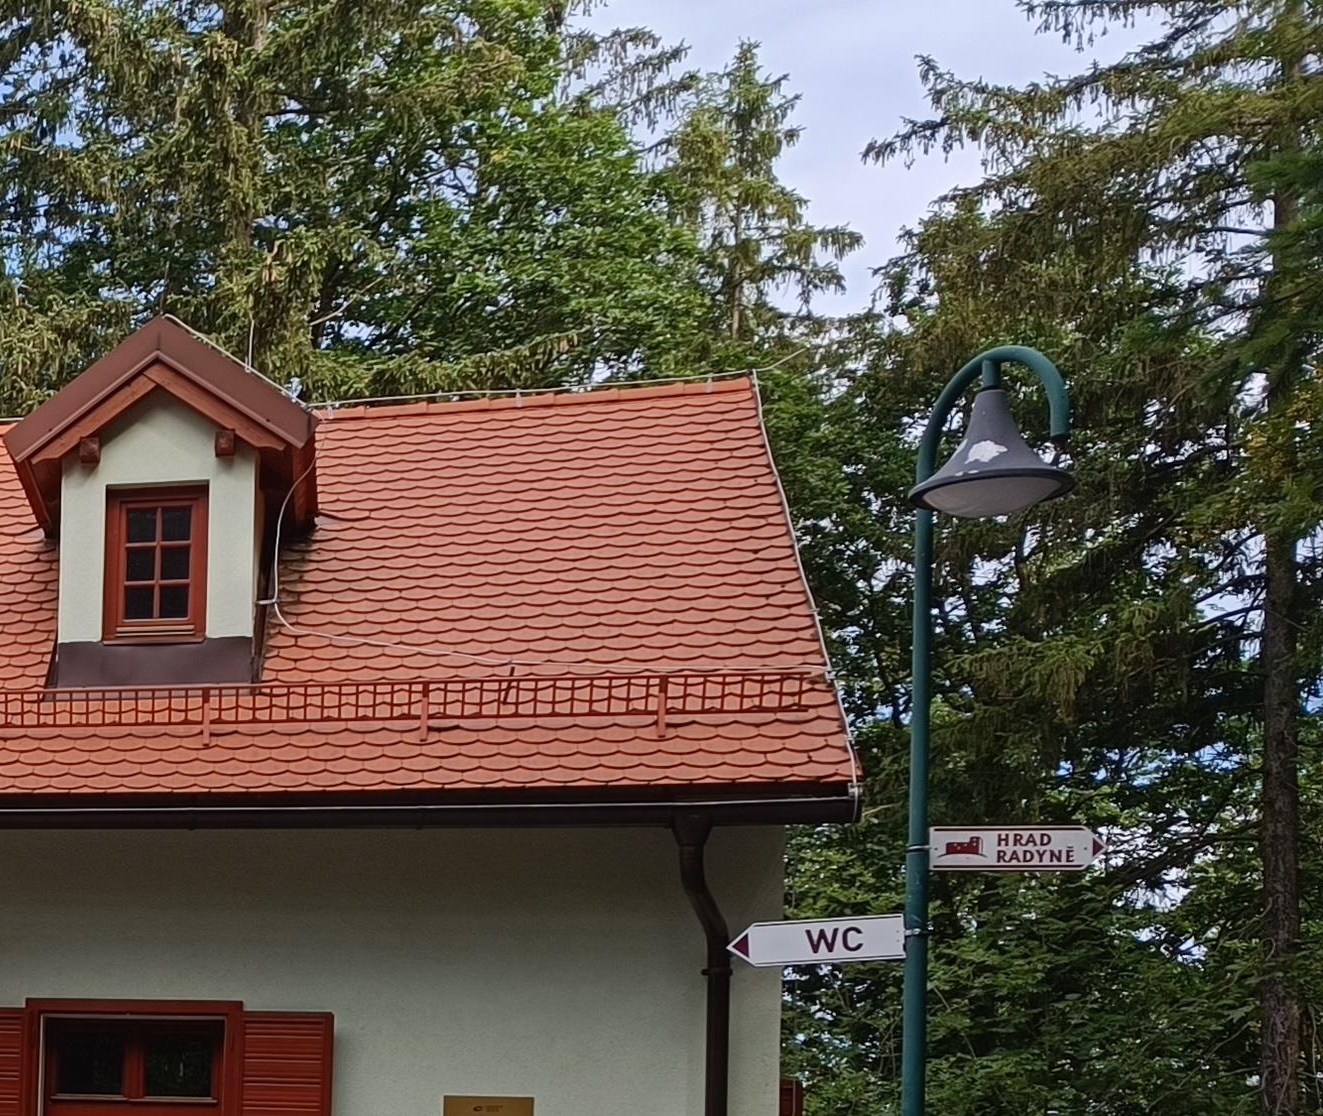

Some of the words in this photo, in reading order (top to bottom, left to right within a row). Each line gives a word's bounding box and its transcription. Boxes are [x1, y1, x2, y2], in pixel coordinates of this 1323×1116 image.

[997, 833, 1052, 847] HRAD
[996, 846, 1075, 863] RADYNĚ
[805, 926, 864, 954] WC
